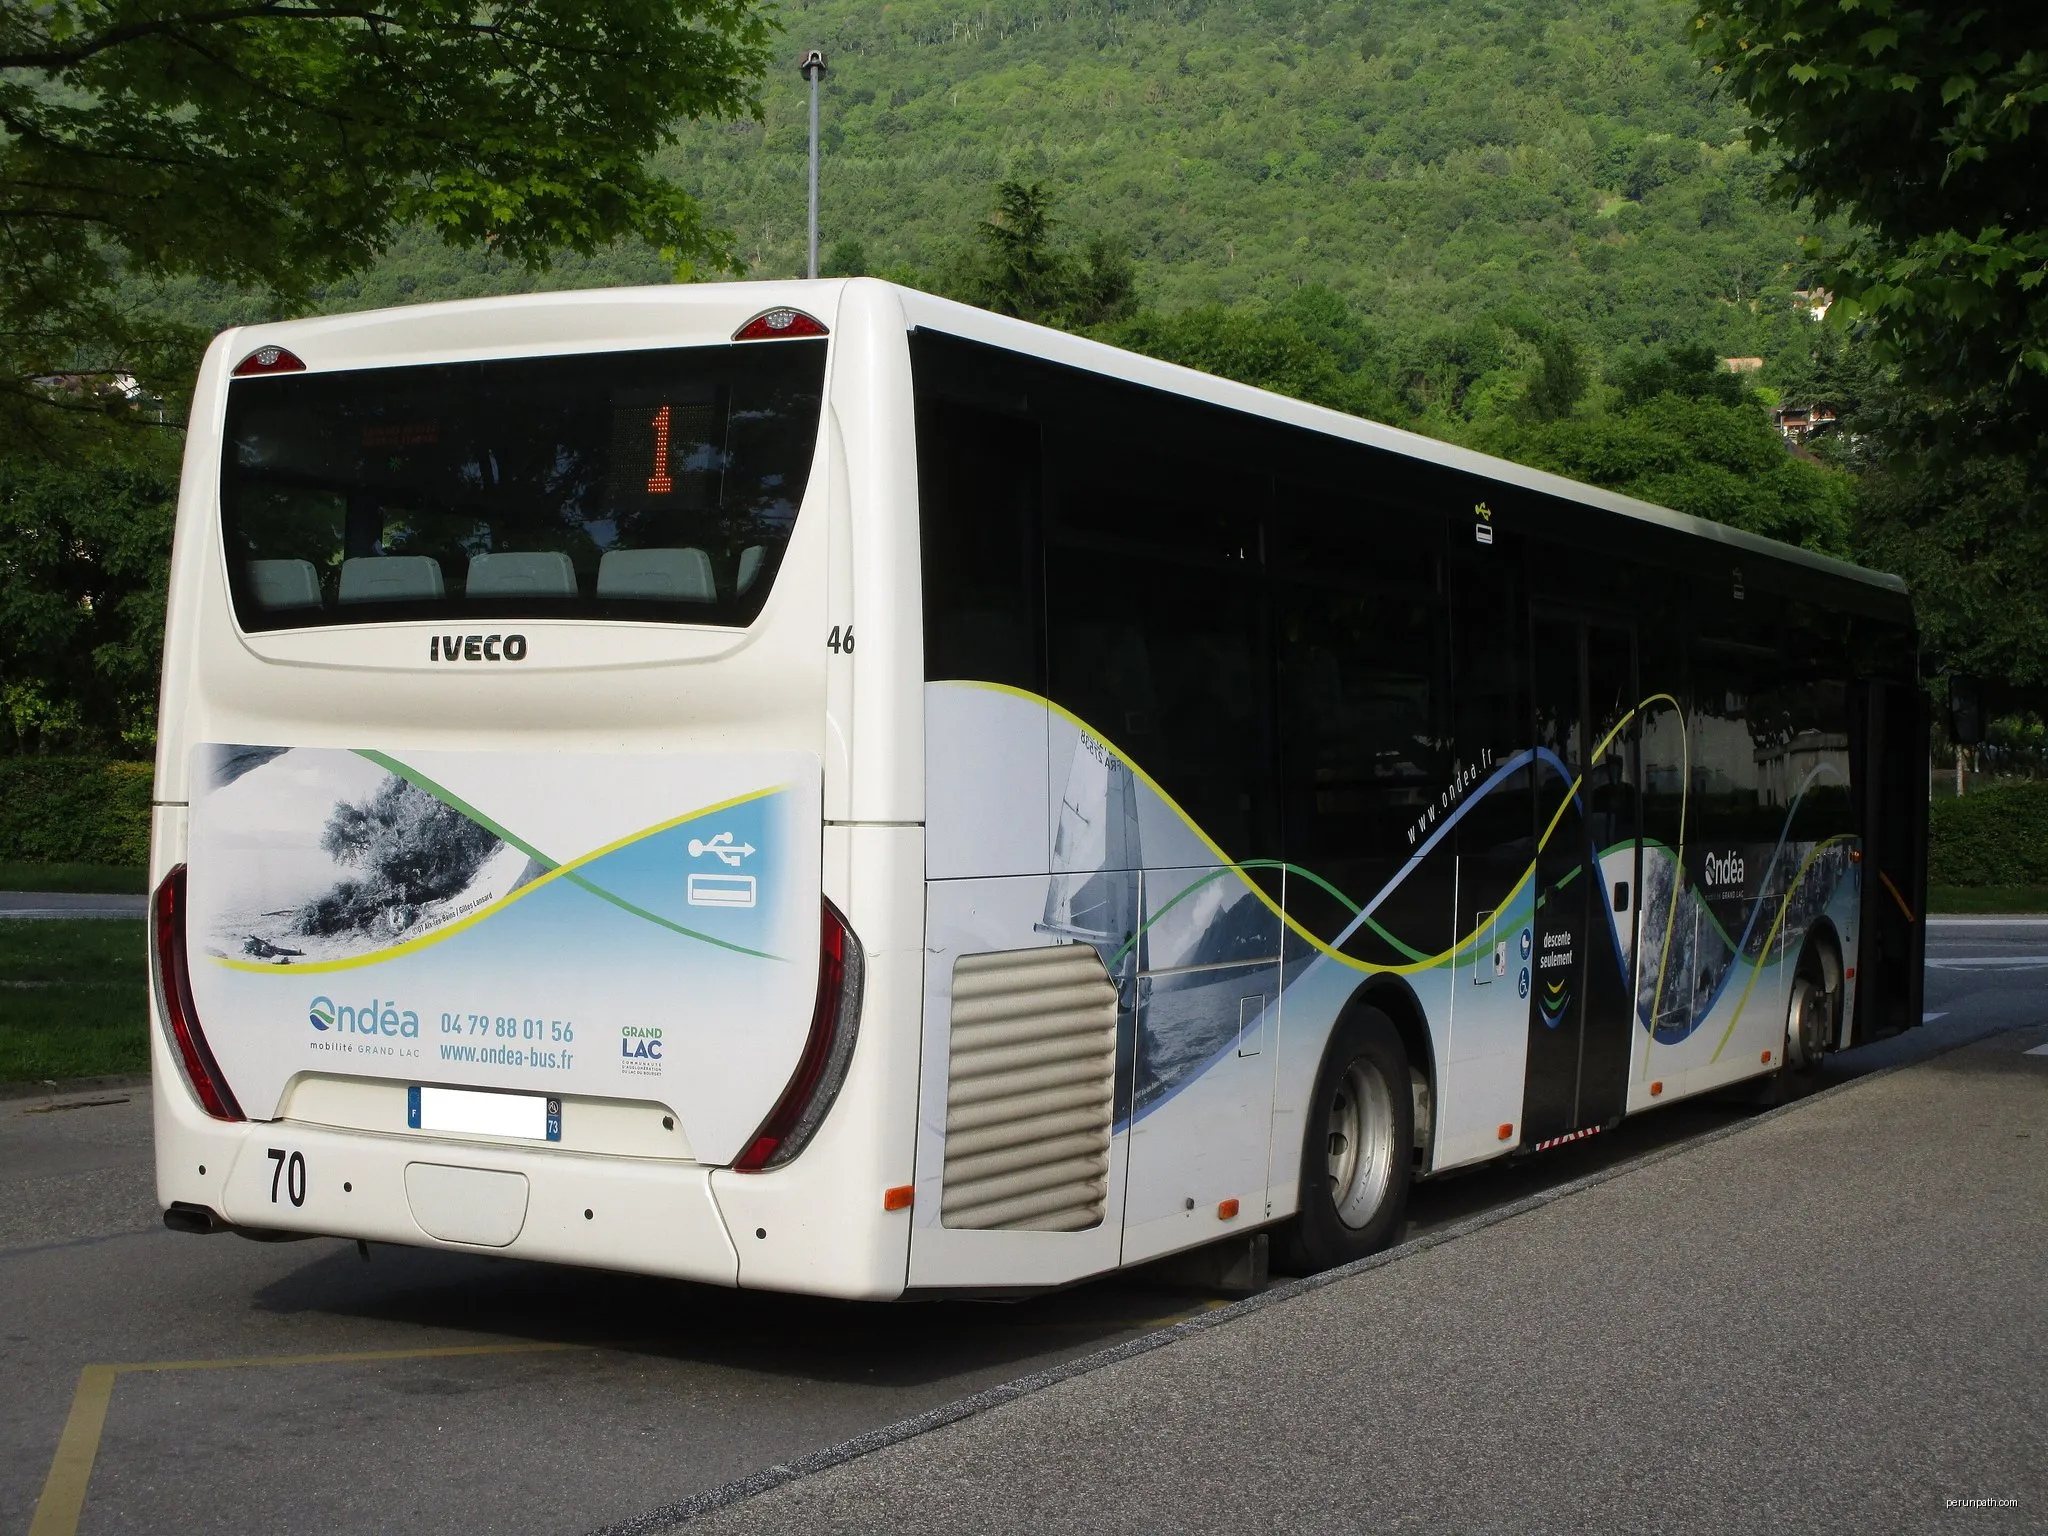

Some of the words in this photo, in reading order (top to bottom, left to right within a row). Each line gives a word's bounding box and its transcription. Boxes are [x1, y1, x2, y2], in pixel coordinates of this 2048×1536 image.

[648, 406, 672, 492] 1
[430, 634, 527, 661] IVECO
[827, 625, 855, 654] 46
[1407, 748, 1491, 844] www.ondea.fr
[1705, 850, 1744, 886] Ondéa
[473, 892, 493, 907] Lansard
[1544, 931, 1571, 948] descente
[1540, 950, 1572, 968] seulement
[309, 996, 419, 1037] Ondéa
[441, 1013, 462, 1034] 04
[468, 1015, 489, 1036] 79
[495, 1017, 517, 1038] 88
[523, 1019, 543, 1040] 01
[551, 1021, 573, 1042] 56
[622, 1026, 663, 1038] GRAND
[310, 1042, 353, 1052] mobilité
[358, 1045, 394, 1056] GRAND
[400, 1049, 420, 1057] LAC
[440, 1044, 573, 1069] www.ondea-bus.fr
[622, 1038, 662, 1059] LAC
[412, 1109, 416, 1117] F
[548, 1120, 559, 1134] 73
[268, 1148, 306, 1207] 70
